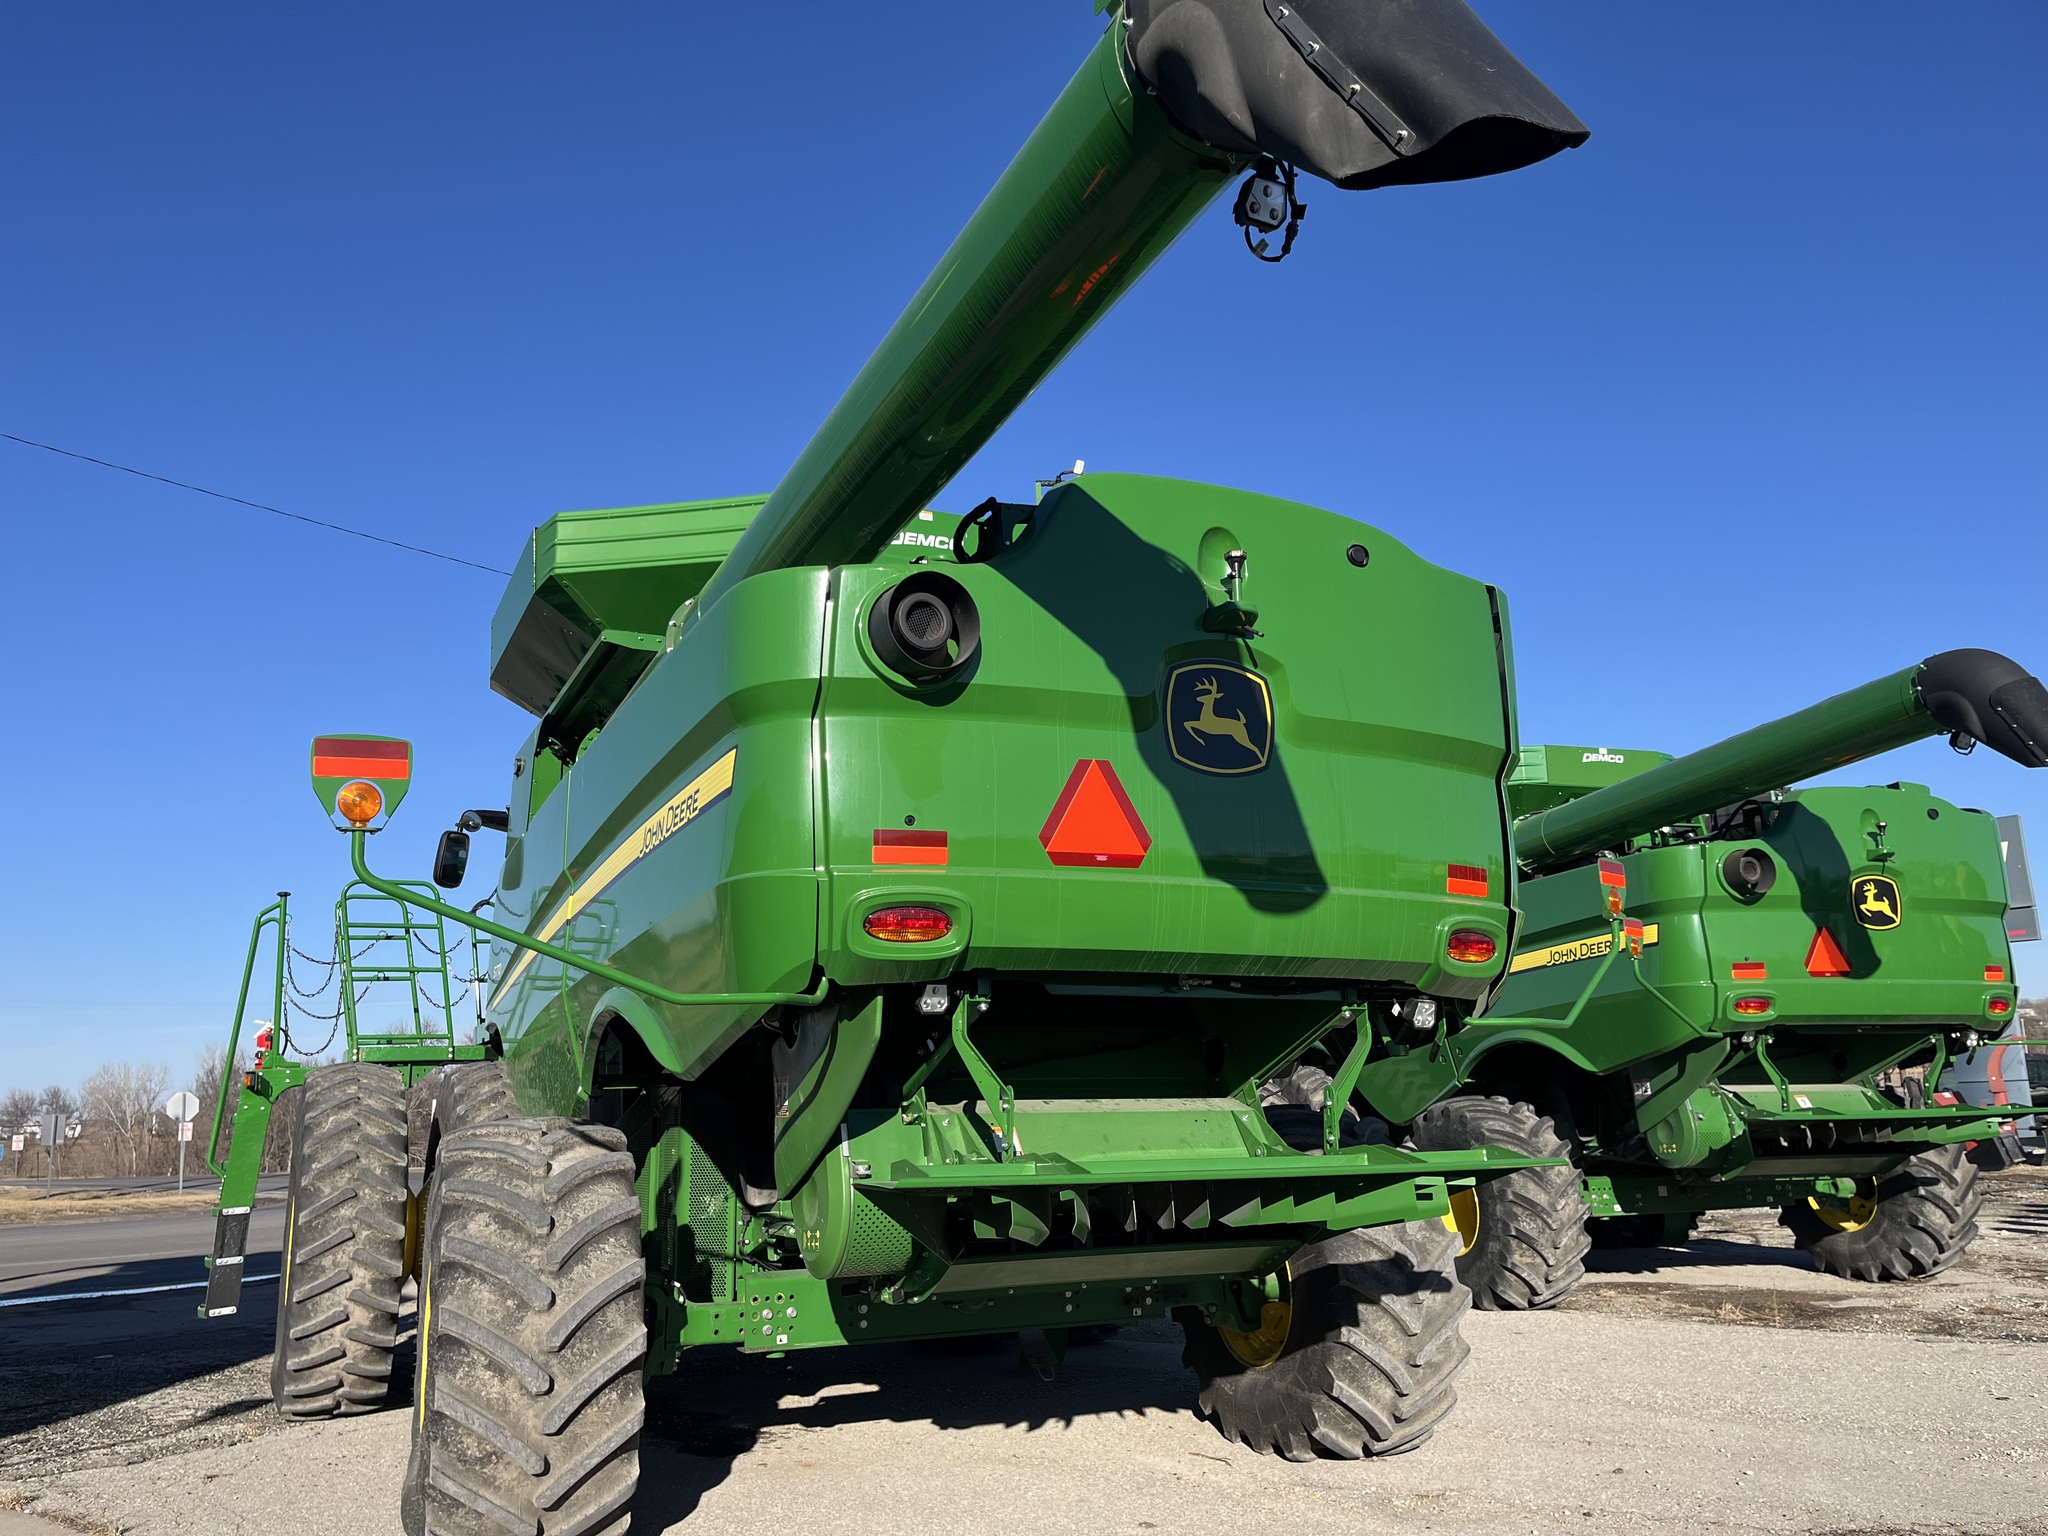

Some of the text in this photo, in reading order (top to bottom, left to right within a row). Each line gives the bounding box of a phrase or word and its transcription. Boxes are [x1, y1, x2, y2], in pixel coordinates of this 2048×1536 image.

[1582, 752, 1624, 764] DEMCO
[639, 788, 700, 856] JOHN DEERE
[1547, 940, 1613, 964] JOHN DEER
